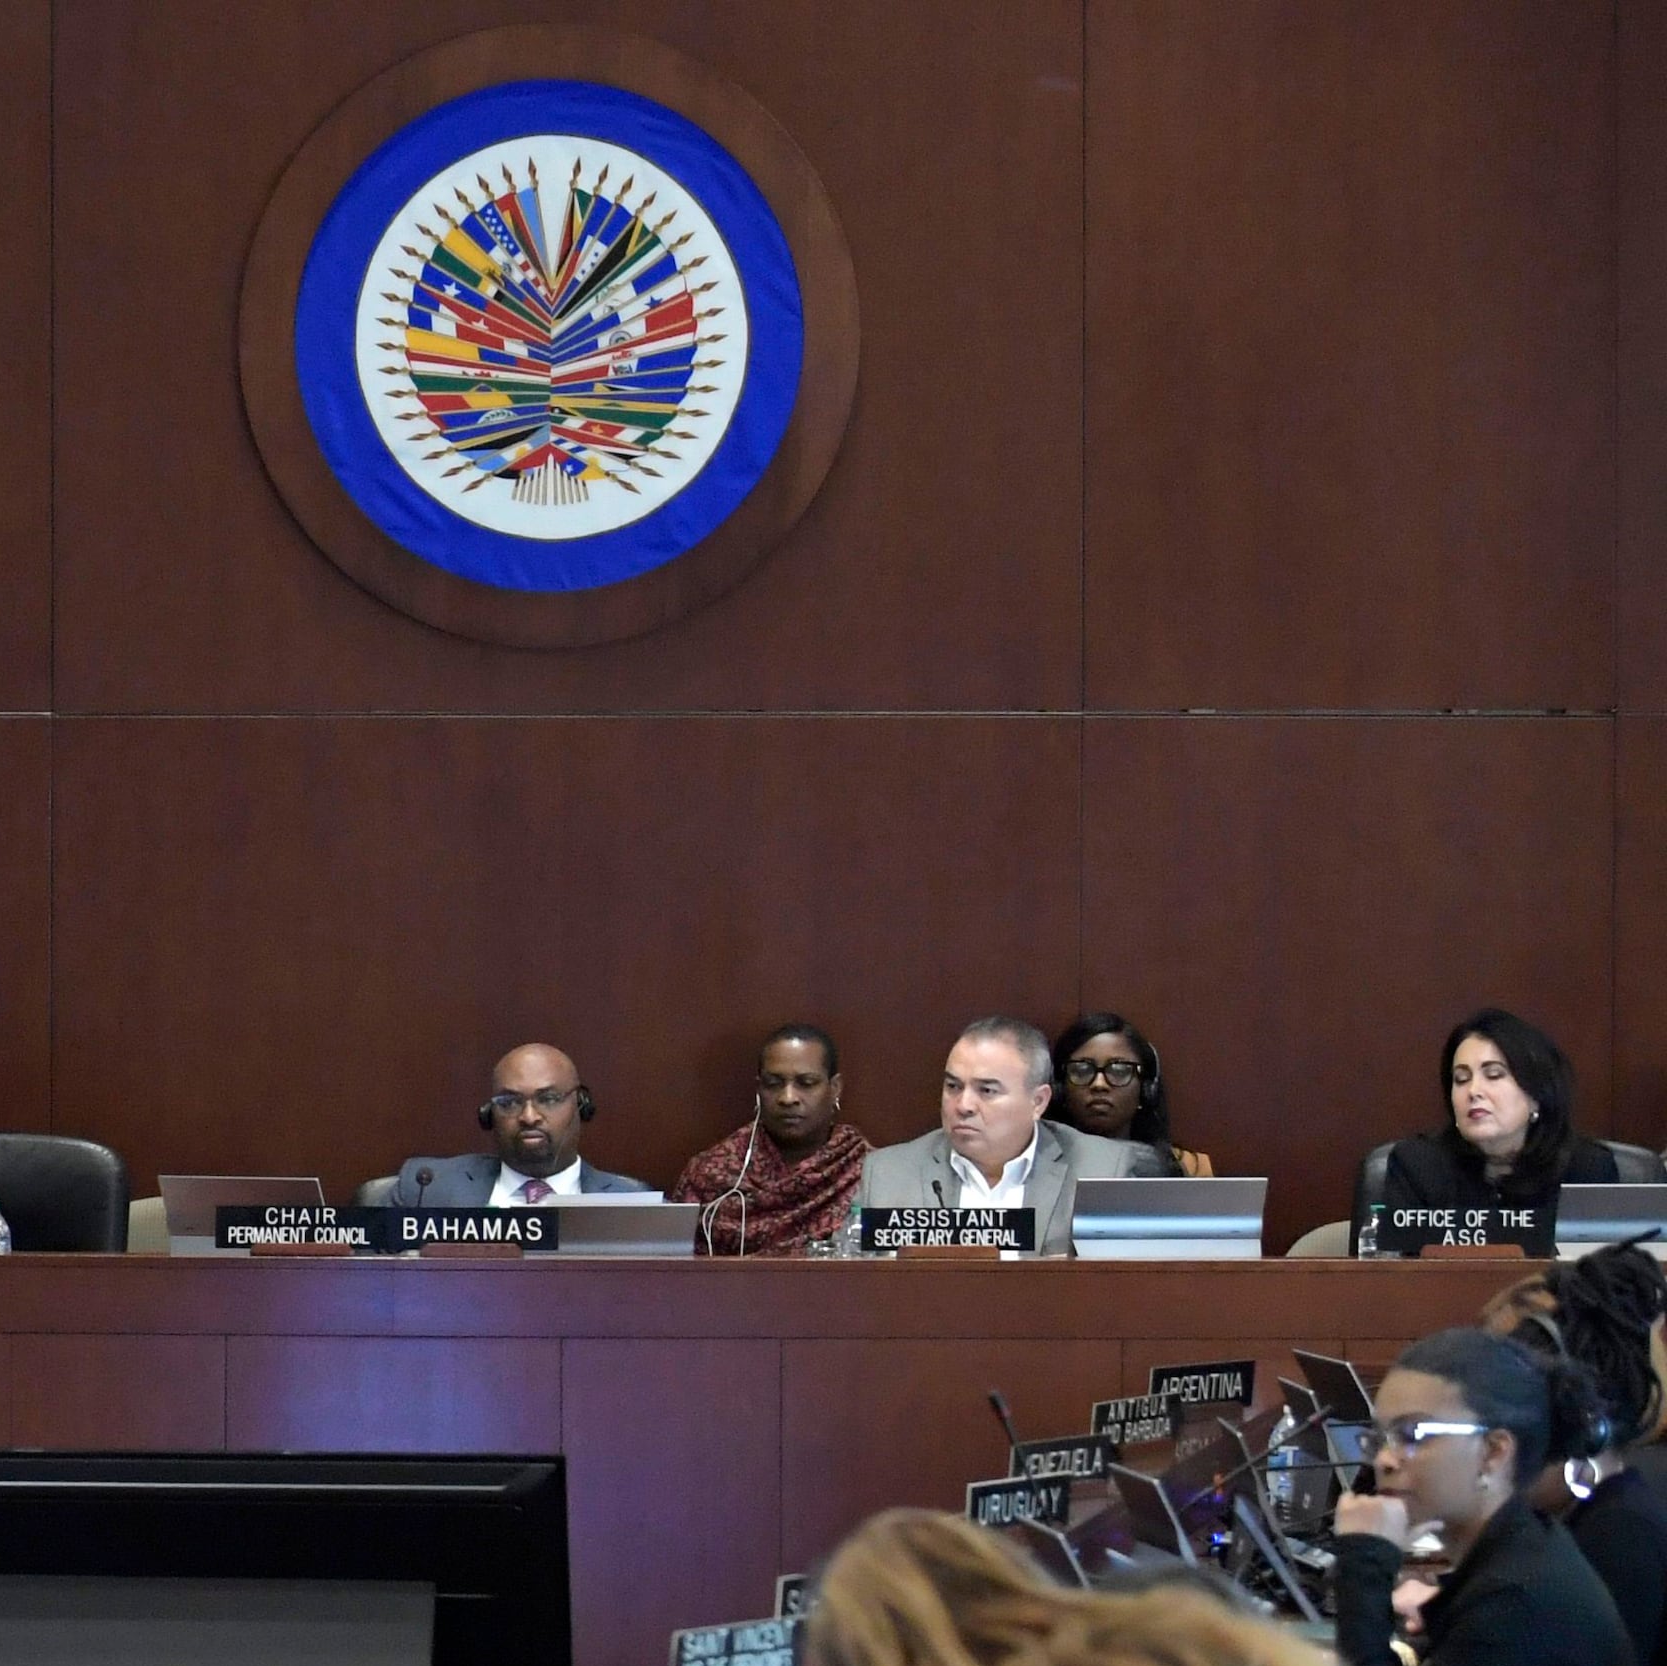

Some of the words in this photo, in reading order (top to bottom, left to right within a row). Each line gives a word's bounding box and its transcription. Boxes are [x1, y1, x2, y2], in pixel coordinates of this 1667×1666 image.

[265, 1206, 337, 1226] CHAIR
[887, 1208, 1008, 1229] ASSISTANT
[1392, 1209, 1459, 1230] OFFICE
[1464, 1209, 1490, 1228] OF
[1499, 1208, 1535, 1228] THE
[227, 1225, 311, 1245] PERMANENT
[313, 1226, 371, 1246] COUNCIL
[402, 1216, 544, 1242] BAHAMAS
[873, 1228, 954, 1247] SECRETARY
[959, 1229, 1021, 1248] GENERAL
[1160, 1371, 1243, 1403] ARGENTINA
[1107, 1394, 1167, 1423] ANTIGUA
